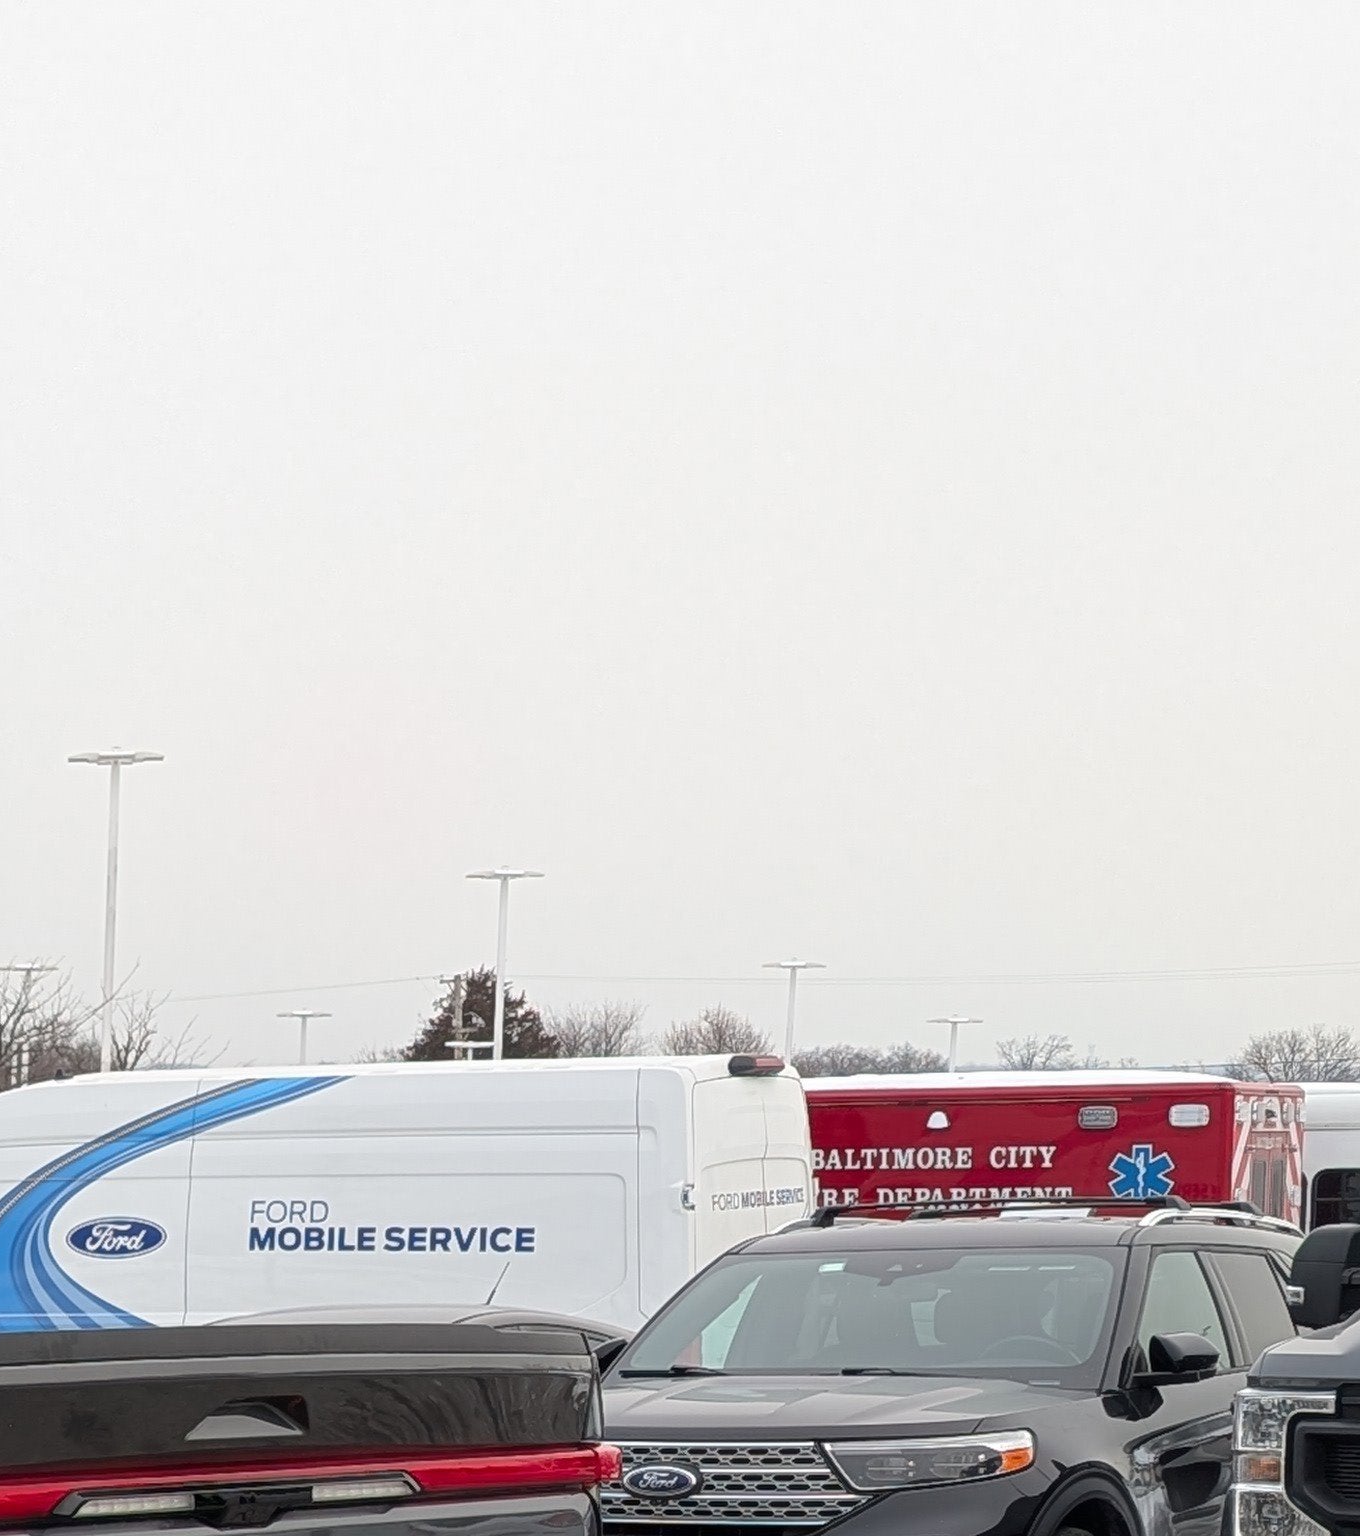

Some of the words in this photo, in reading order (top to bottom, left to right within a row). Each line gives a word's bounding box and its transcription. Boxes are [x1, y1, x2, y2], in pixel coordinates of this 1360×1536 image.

[811, 1147, 972, 1170] BALTIMORE
[989, 1145, 1057, 1169] CITY
[249, 1199, 329, 1224] FORD
[711, 1193, 740, 1212] FORD
[741, 1190, 775, 1209] MOBILE
[776, 1187, 804, 1205] SERVICE
[85, 1223, 146, 1252] Ford
[248, 1226, 376, 1252] MOBILE
[382, 1226, 536, 1253] SERVICE
[638, 1471, 679, 1489] Ford
